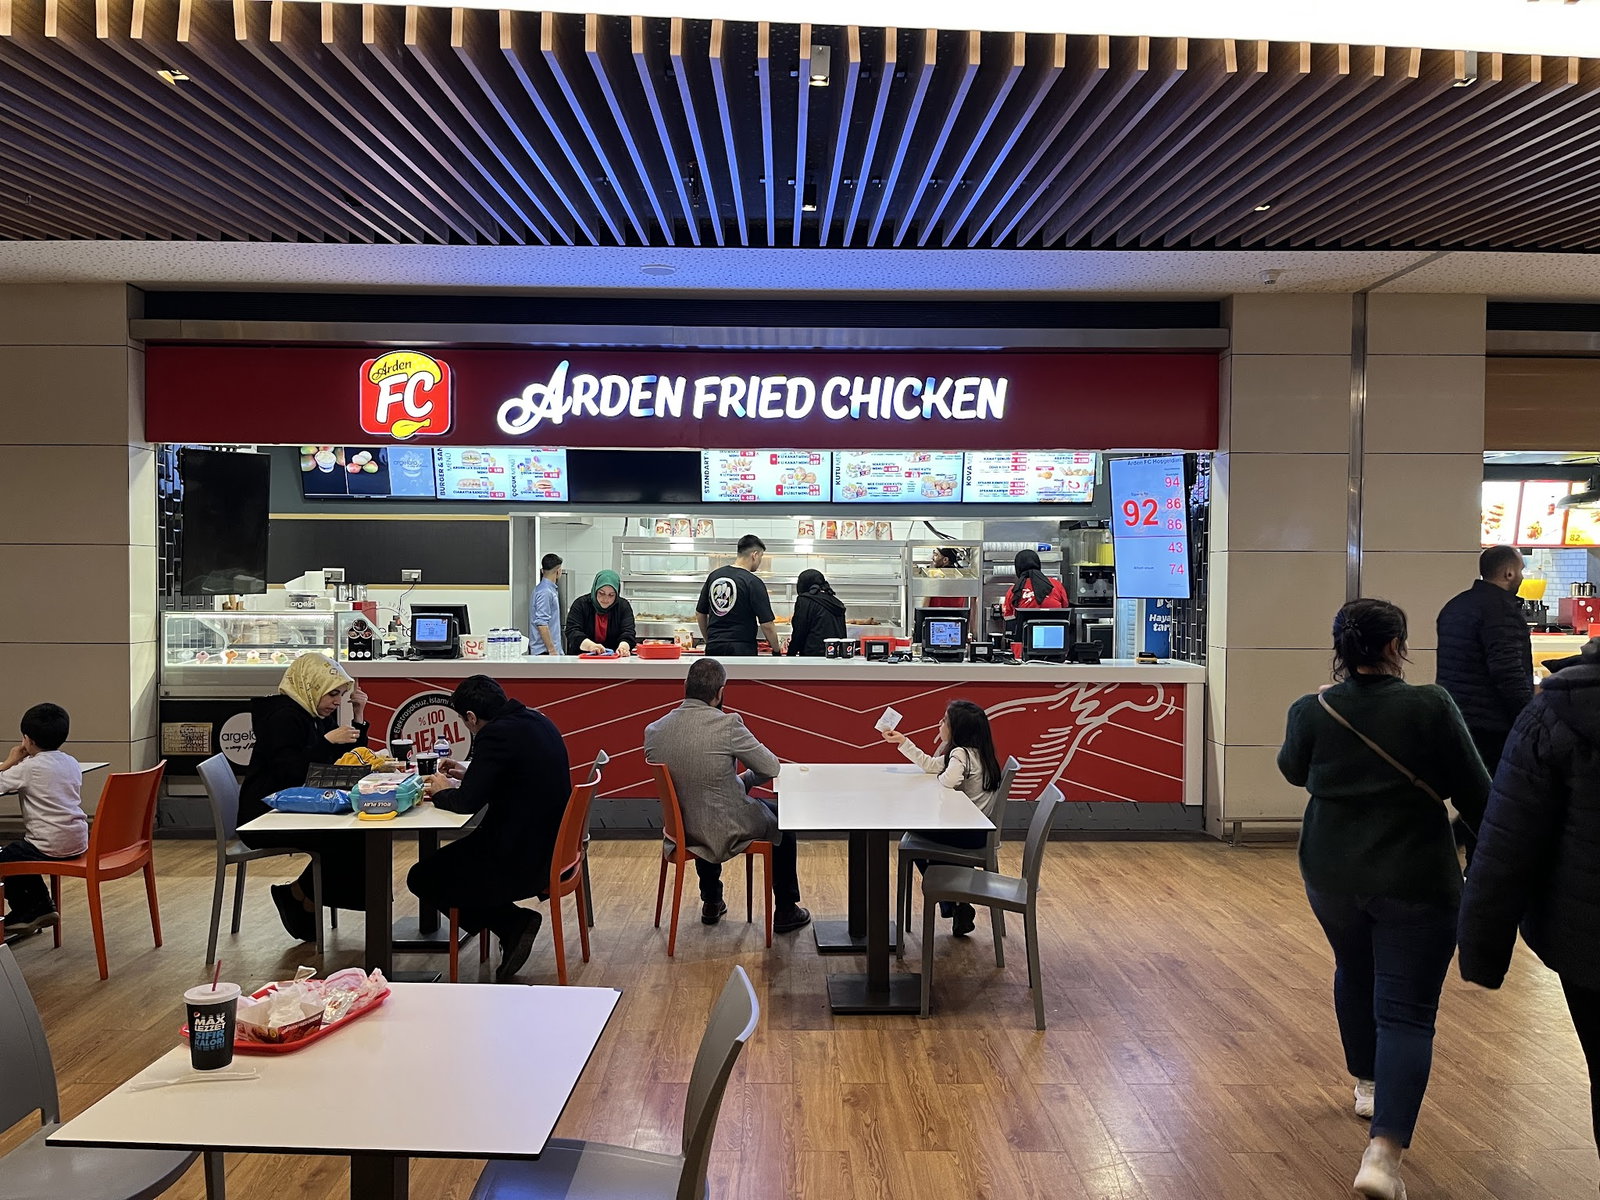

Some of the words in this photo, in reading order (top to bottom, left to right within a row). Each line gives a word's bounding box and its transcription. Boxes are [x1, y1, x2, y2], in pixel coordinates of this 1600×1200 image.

[372, 360, 412, 381] Arden
[375, 370, 434, 424] FC
[496, 360, 687, 435] ARDEN
[692, 375, 816, 419] FRIED
[821, 376, 1008, 420] CHICKEN
[1164, 476, 1180, 488] 94
[1166, 498, 1181, 510] 86
[1122, 498, 1159, 527] 92
[1167, 519, 1182, 531] 86
[1168, 541, 1183, 553] 43
[1169, 563, 1184, 575] 74
[406, 721, 465, 754] HELAL
[194, 1015, 226, 1026] MAX
[194, 1022, 227, 1032] LEZZET
